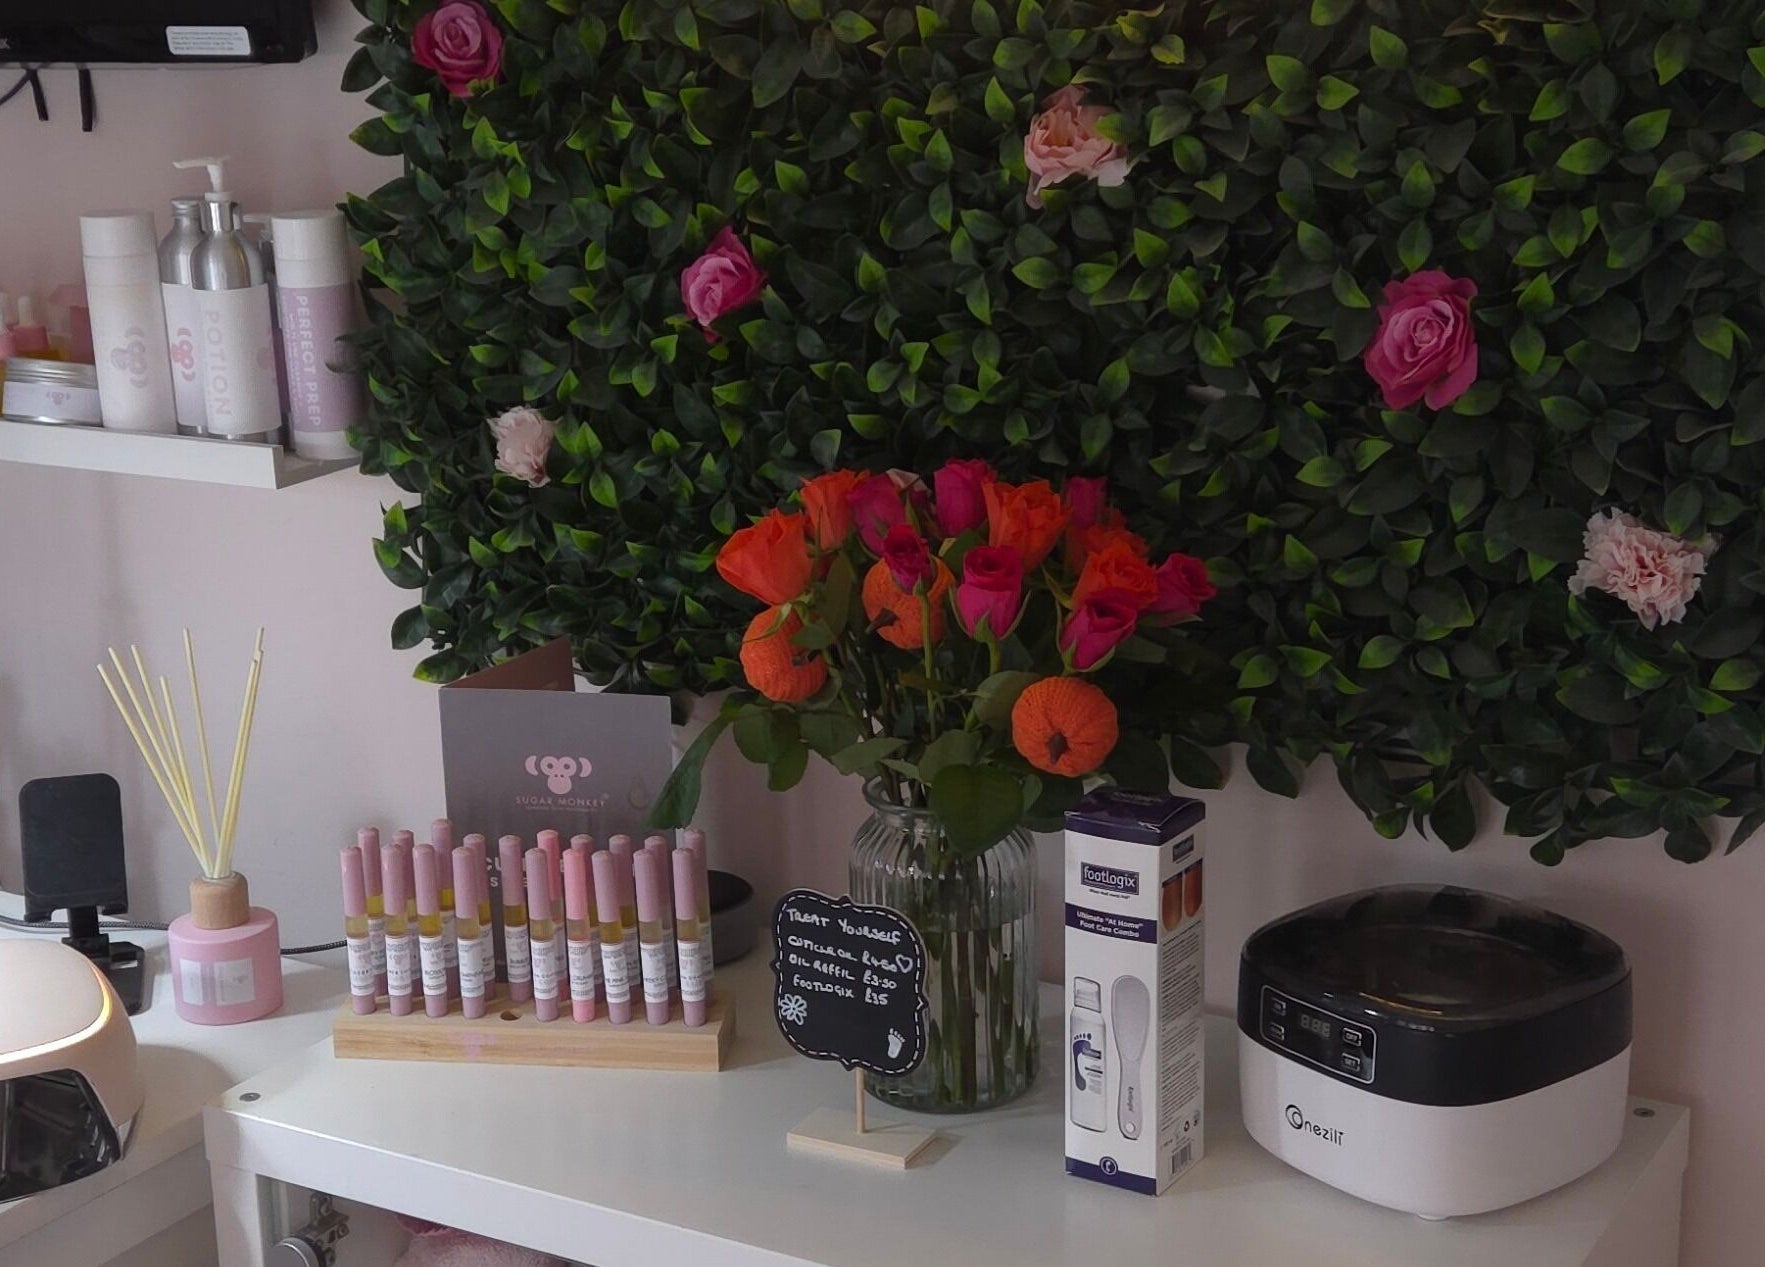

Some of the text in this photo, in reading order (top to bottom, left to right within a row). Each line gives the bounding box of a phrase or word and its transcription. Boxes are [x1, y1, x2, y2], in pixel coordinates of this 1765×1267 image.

[206, 310, 233, 417] POTION
[295, 295, 321, 427] PERFECT PREP
[515, 796, 605, 808] SUGAR MONKEY
[1083, 866, 1136, 889] footlogix
[786, 908, 901, 945] TREAT YOURSELF
[1076, 910, 1104, 923] Ultimate
[1079, 921, 1140, 938] Foot Care Combo
[788, 953, 809, 966] OIL
[793, 973, 888, 1005] FOOTLOGIX £35
